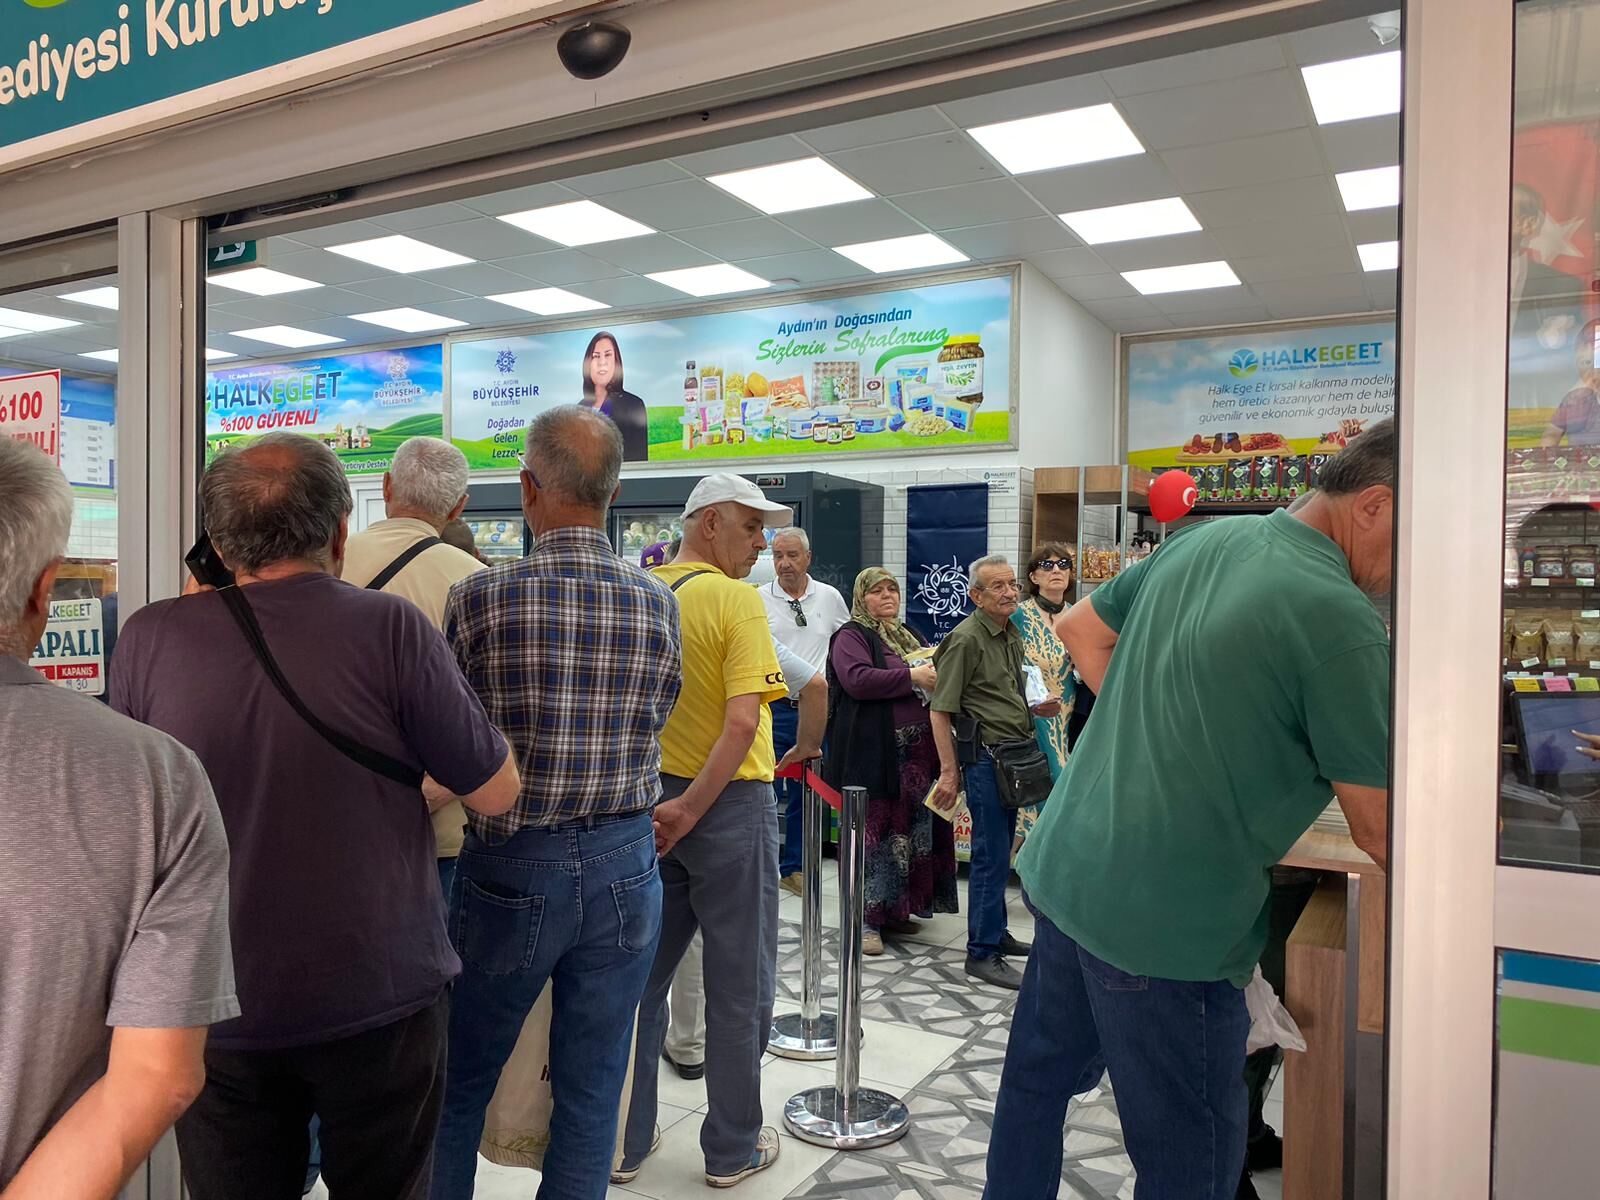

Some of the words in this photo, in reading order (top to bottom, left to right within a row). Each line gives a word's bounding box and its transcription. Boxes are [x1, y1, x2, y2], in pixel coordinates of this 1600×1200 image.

[146, 0, 333, 57] Kuru
[778, 319, 827, 336] Aydın'ın
[834, 307, 912, 330] Doğasından
[756, 339, 828, 365] Sizlerin
[833, 326, 951, 356] Sofralarına
[1262, 342, 1383, 366] HALKEGEET
[214, 371, 342, 409] HALKEGEET
[375, 387, 421, 398] BÜYÜKŞEHİR
[473, 384, 539, 399] BÜYÜKŞEHİR
[1207, 384, 1230, 396] Halk
[1233, 383, 1252, 396] Ege
[1255, 382, 1265, 393] Et
[1268, 380, 1296, 391] kırsal
[1299, 378, 1348, 390] kalkınma
[1351, 373, 1395, 386] modeliy
[1212, 398, 1236, 409] hem
[1273, 394, 1327, 406] kazanıyor
[1328, 391, 1354, 402] hem
[1356, 389, 1371, 400] de
[220, 415, 254, 432] %100
[257, 406, 319, 430] GÜVENLİ
[488, 417, 525, 430] Doğadan
[1199, 410, 1242, 425] güvenilir
[1246, 411, 1259, 420] ve
[1261, 407, 1315, 420] ekonomik
[1317, 404, 1357, 418] gıdayla
[494, 433, 518, 444] Gelen
[342, 461, 366, 471] reticiye
[367, 459, 387, 469] Destek
[48, 603, 91, 618] KEGEET
[32, 629, 100, 658] APALI
[62, 667, 93, 676] KAPANIŞ
